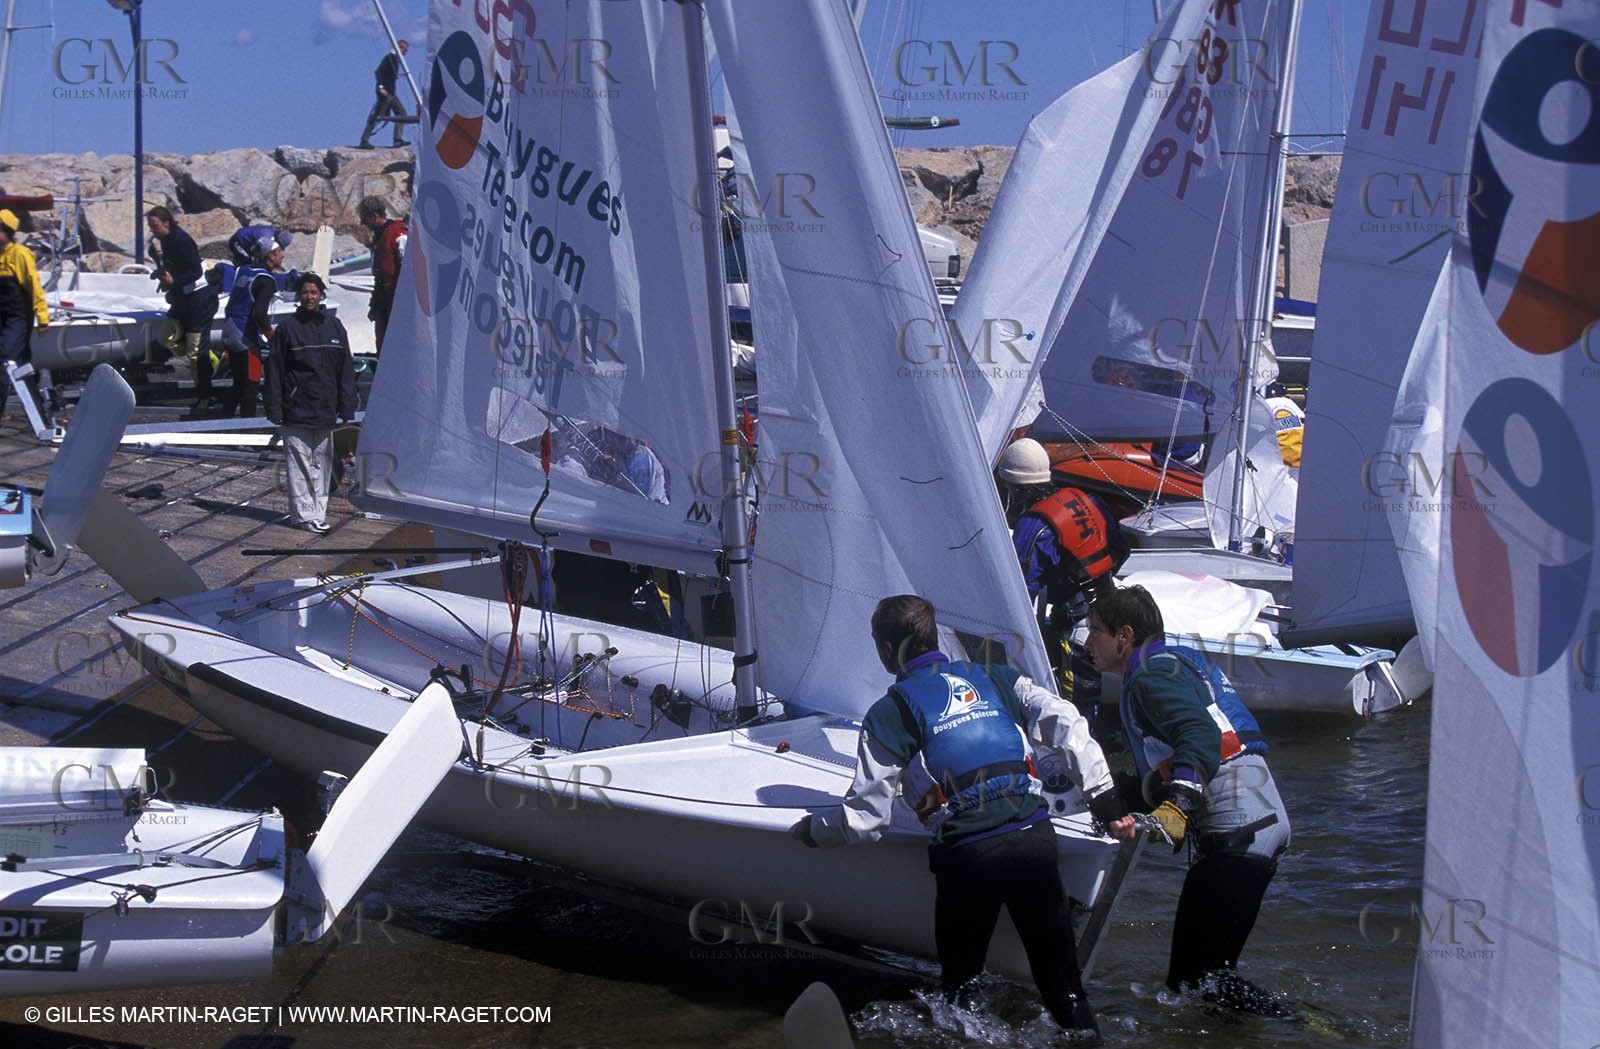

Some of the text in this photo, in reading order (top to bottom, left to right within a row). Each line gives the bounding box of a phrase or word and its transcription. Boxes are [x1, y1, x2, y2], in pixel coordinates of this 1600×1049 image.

[486, 70, 622, 236] Bygues
[482, 140, 586, 295] Teecom
[932, 709, 1000, 735] Bouygues Telecom
[0, 943, 64, 964] OLE
